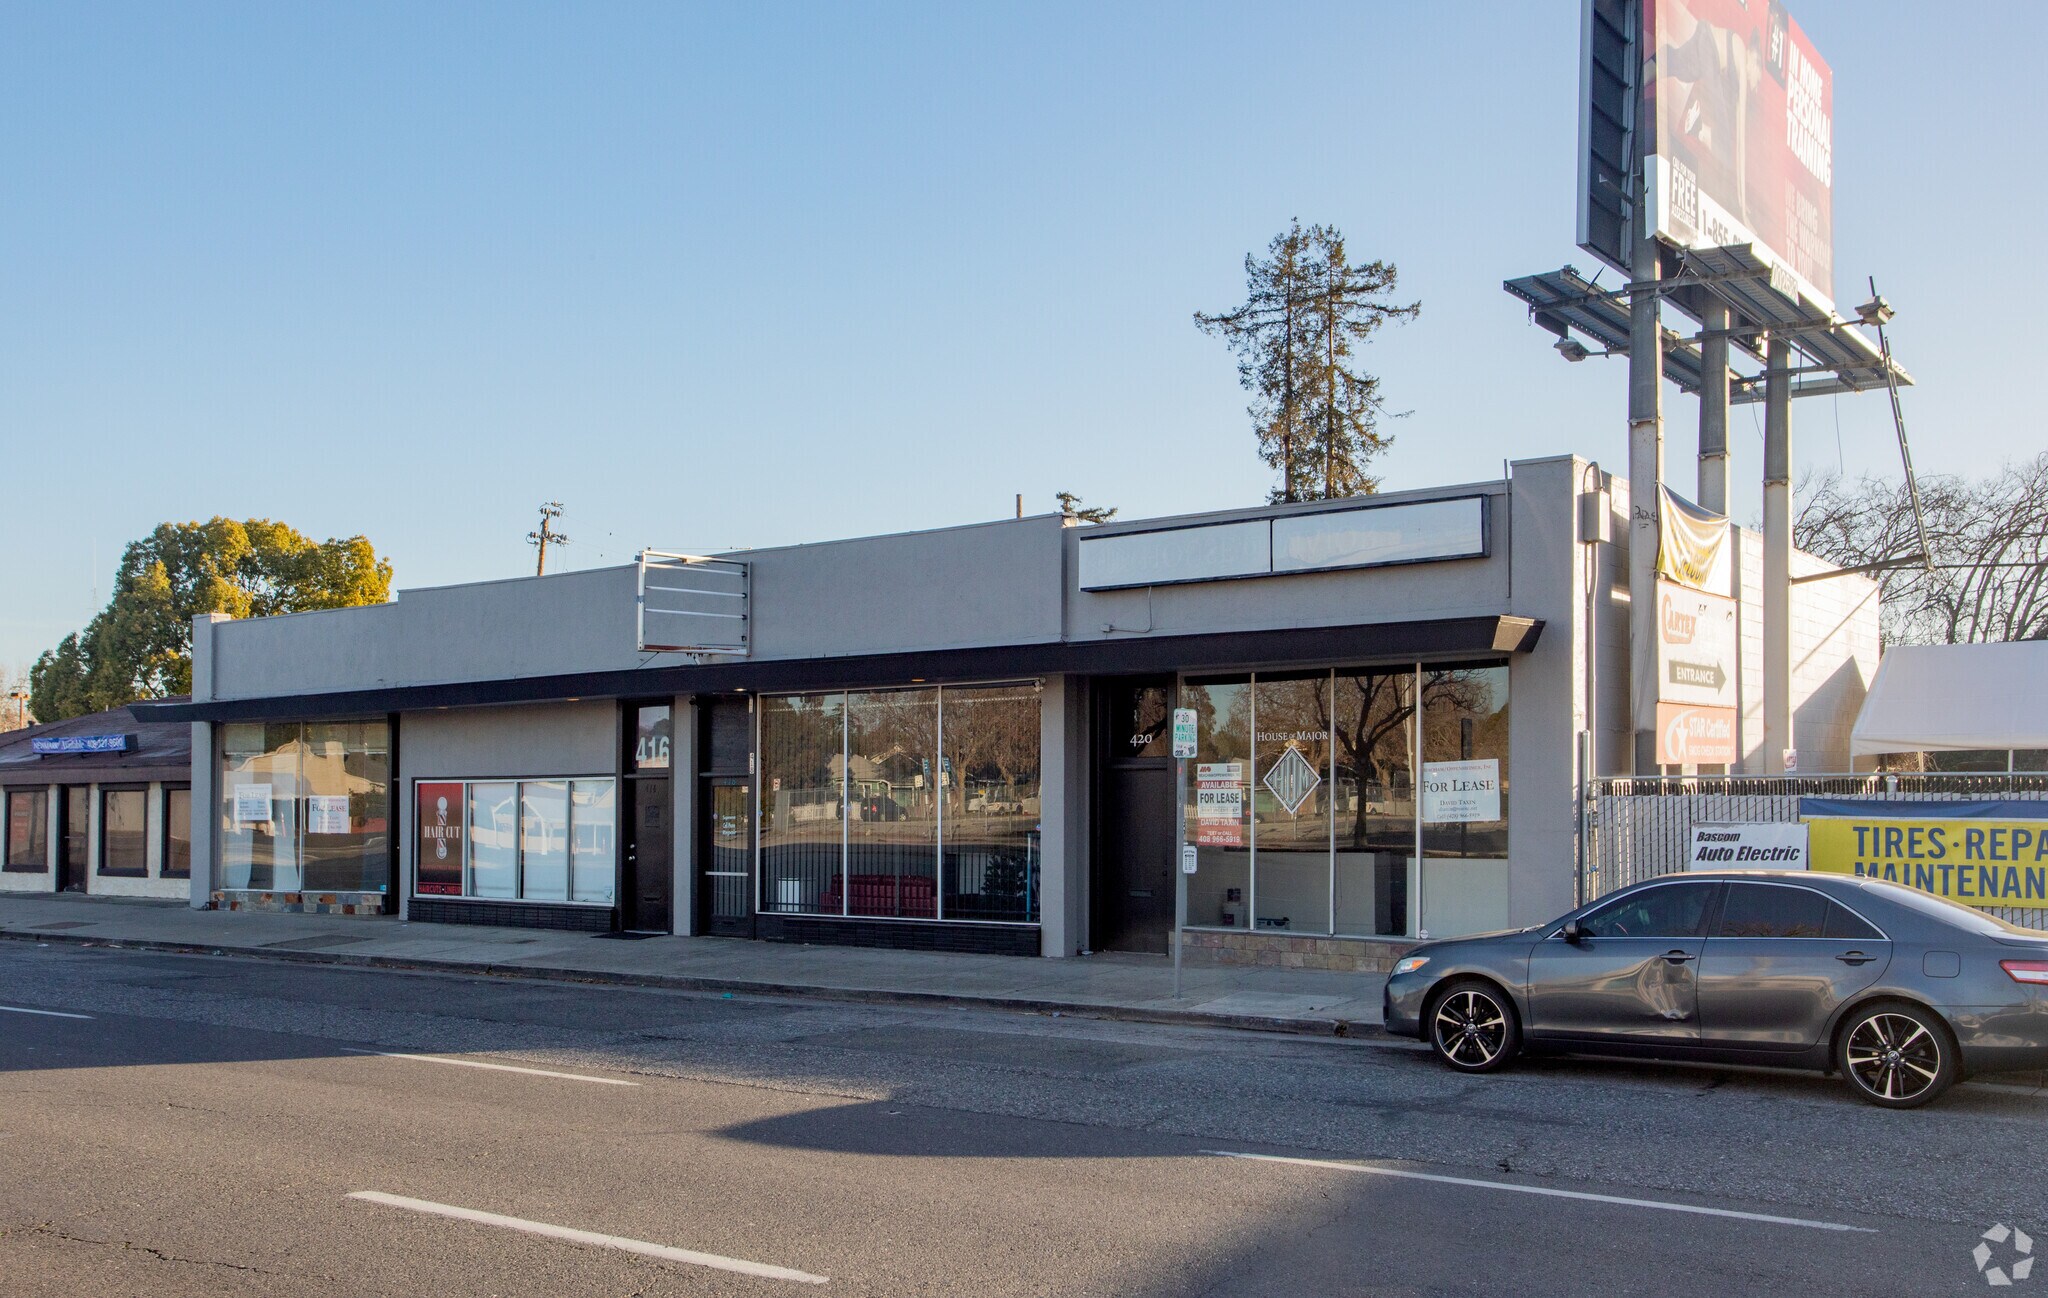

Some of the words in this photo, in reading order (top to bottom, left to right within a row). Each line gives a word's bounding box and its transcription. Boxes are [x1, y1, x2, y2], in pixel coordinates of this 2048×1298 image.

[1771, 24, 1784, 69] #1
[1789, 39, 1800, 77] IN
[1800, 53, 1823, 108] HOME
[1787, 71, 1832, 154] PERSONAL
[1786, 107, 1832, 189] TRAINING
[1672, 167, 1696, 217] FREE
[1796, 189, 1818, 236] BRING
[1662, 593, 1697, 645] CARTEX
[1676, 666, 1715, 684] ENTRANCE
[1181, 714, 1189, 723] 30
[1257, 731, 1288, 742] HOUSE
[1296, 730, 1328, 742] MAJOR
[1689, 717, 1706, 738] STAR
[1706, 718, 1731, 739] Certified
[1130, 734, 1153, 747] 420
[635, 736, 670, 764] 416
[1201, 781, 1239, 789] AVAILABLE
[1423, 781, 1448, 793] FOR
[1452, 779, 1495, 792] LEASE
[1200, 792, 1215, 804] FOR
[1216, 792, 1240, 804] LEASE
[1200, 818, 1220, 826] DAVID
[1220, 818, 1239, 826] TAXIN
[424, 826, 444, 838] HAIR
[445, 826, 461, 839] CUT
[1199, 835, 1211, 843] 408
[1212, 835, 1241, 843] 966-5919
[1697, 831, 1741, 842] Bascom
[1853, 826, 1946, 859] TIRES
[1966, 828, 2048, 861] REPA
[1696, 846, 1735, 861] Auto
[1735, 845, 1801, 861] Electric
